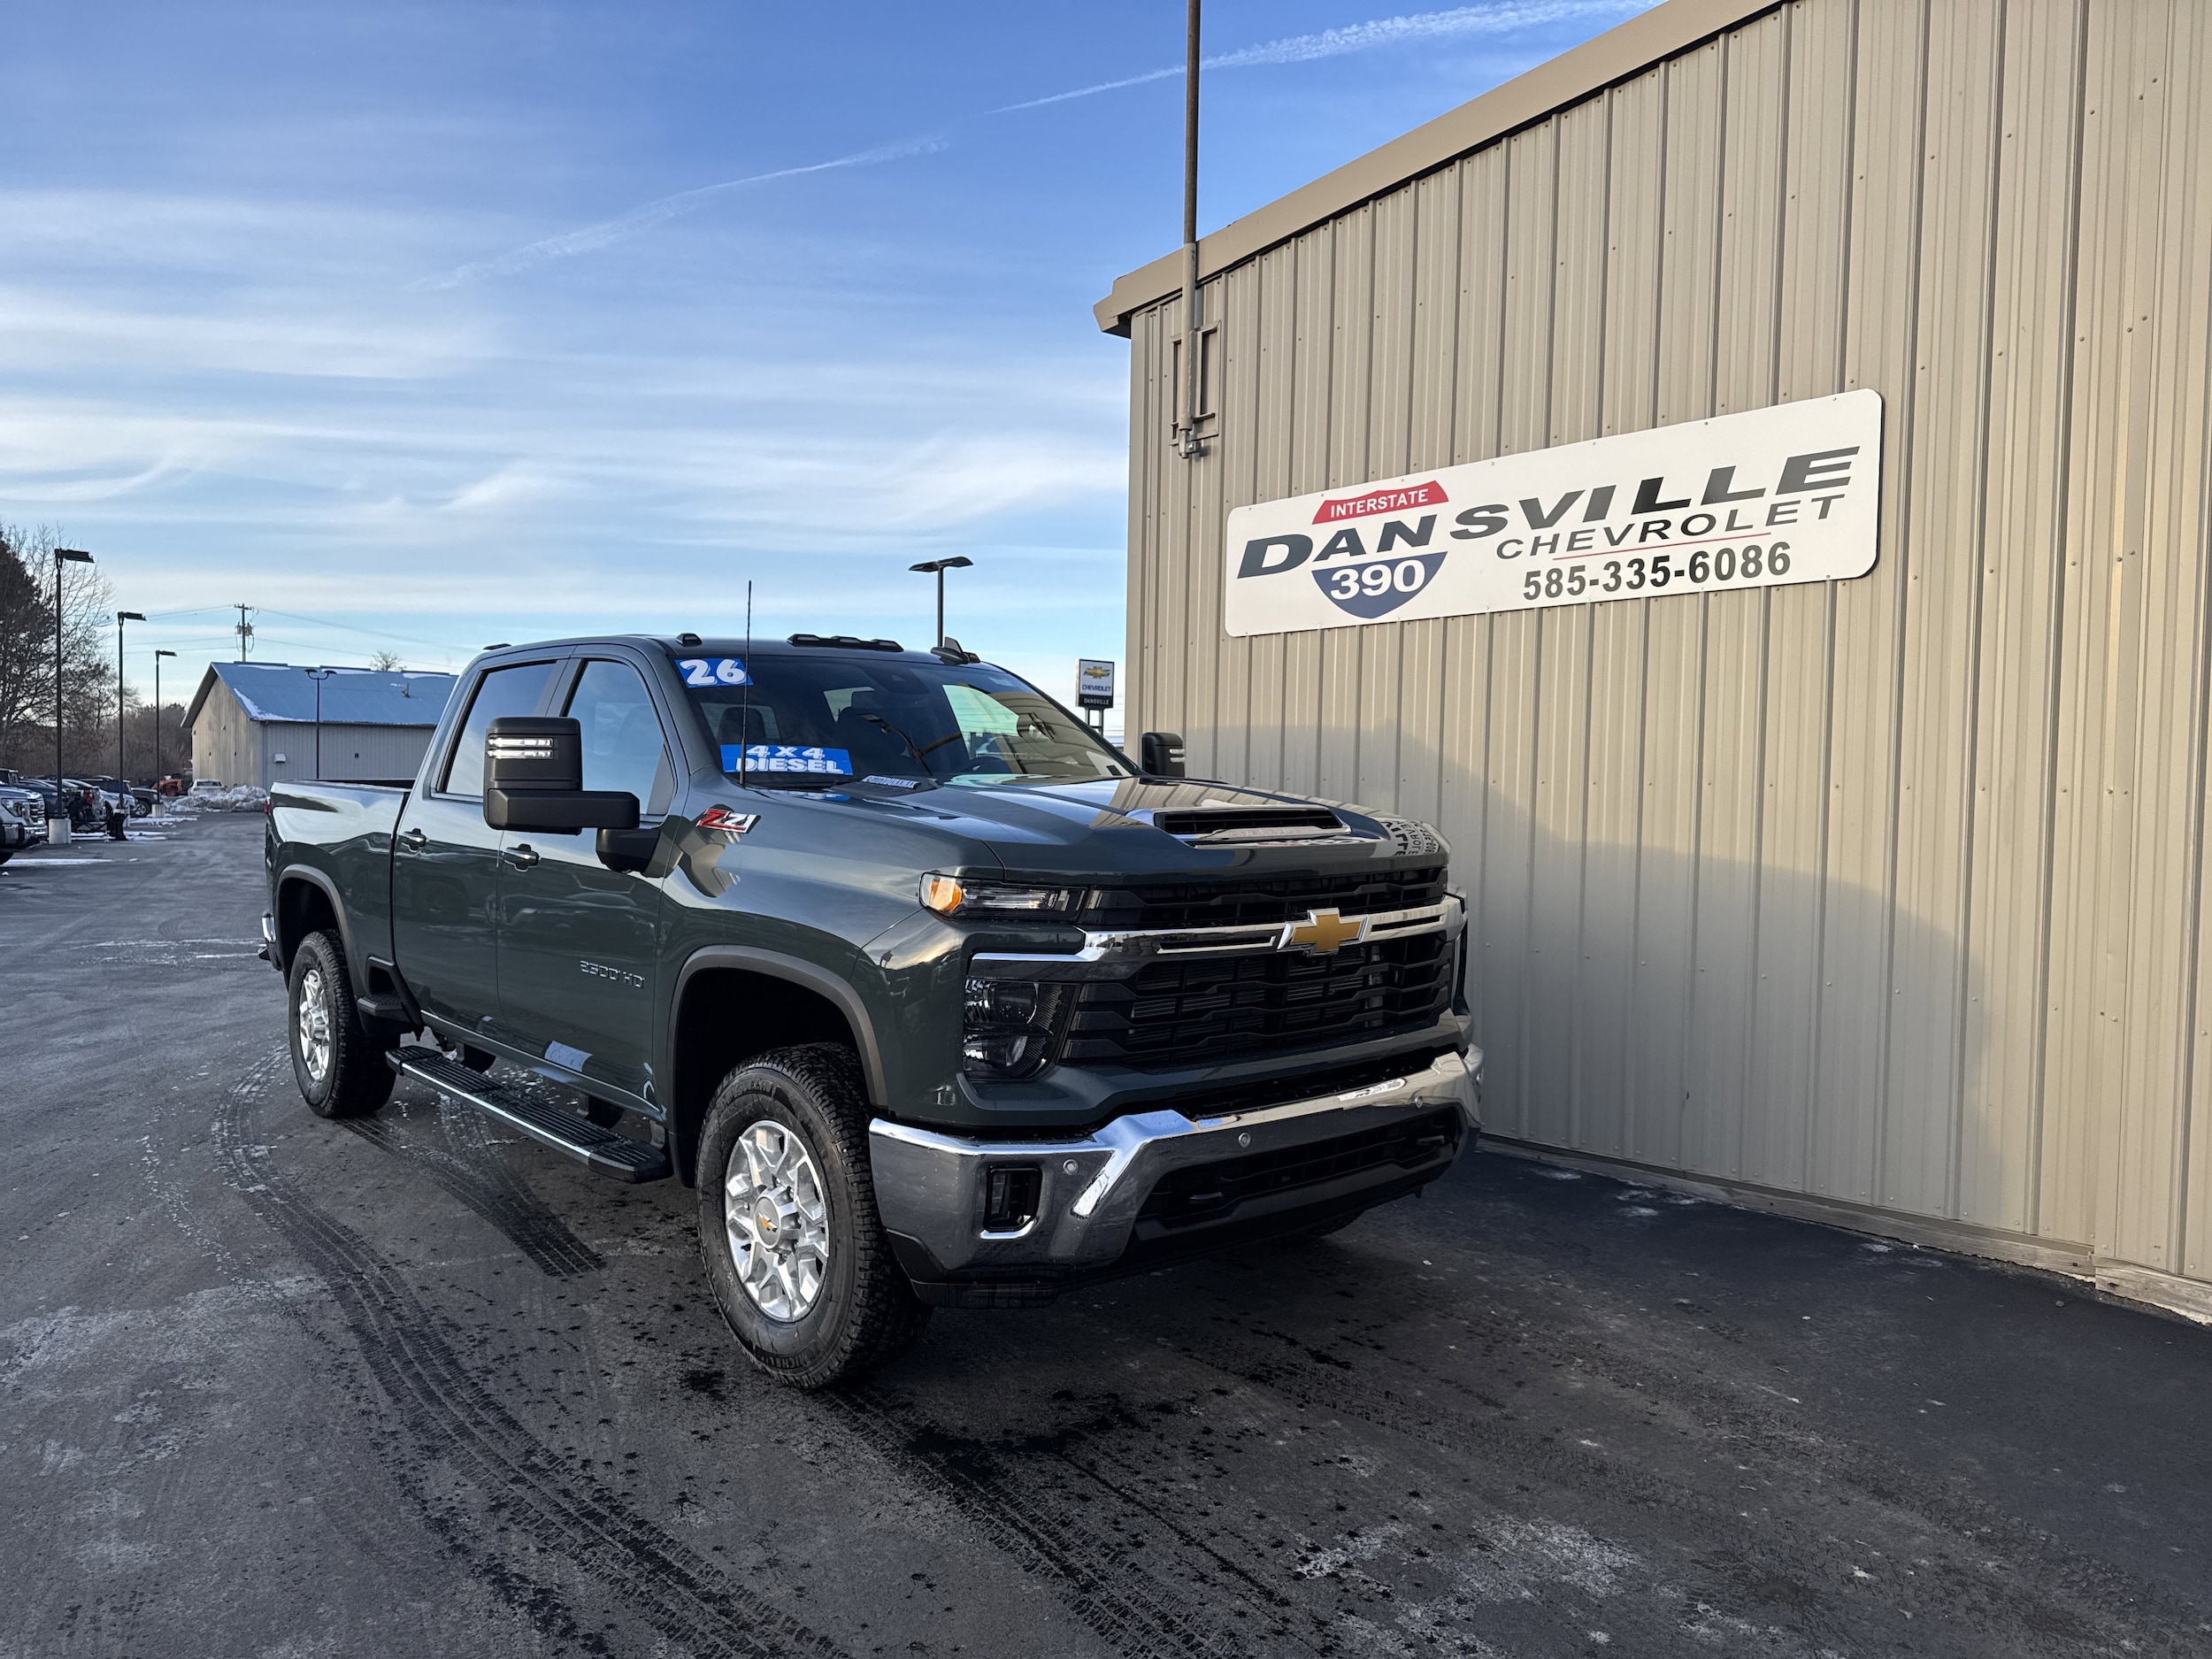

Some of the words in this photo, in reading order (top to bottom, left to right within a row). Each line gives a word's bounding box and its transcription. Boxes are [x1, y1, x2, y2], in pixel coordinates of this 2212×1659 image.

[1330, 488, 1430, 517] INTERSTATE
[1495, 493, 1846, 560] CHEVROLET
[1330, 558, 1426, 602] 390
[1523, 540, 1792, 602] 585-335-6086
[679, 658, 747, 686] 26
[735, 757, 844, 774] DIESEL
